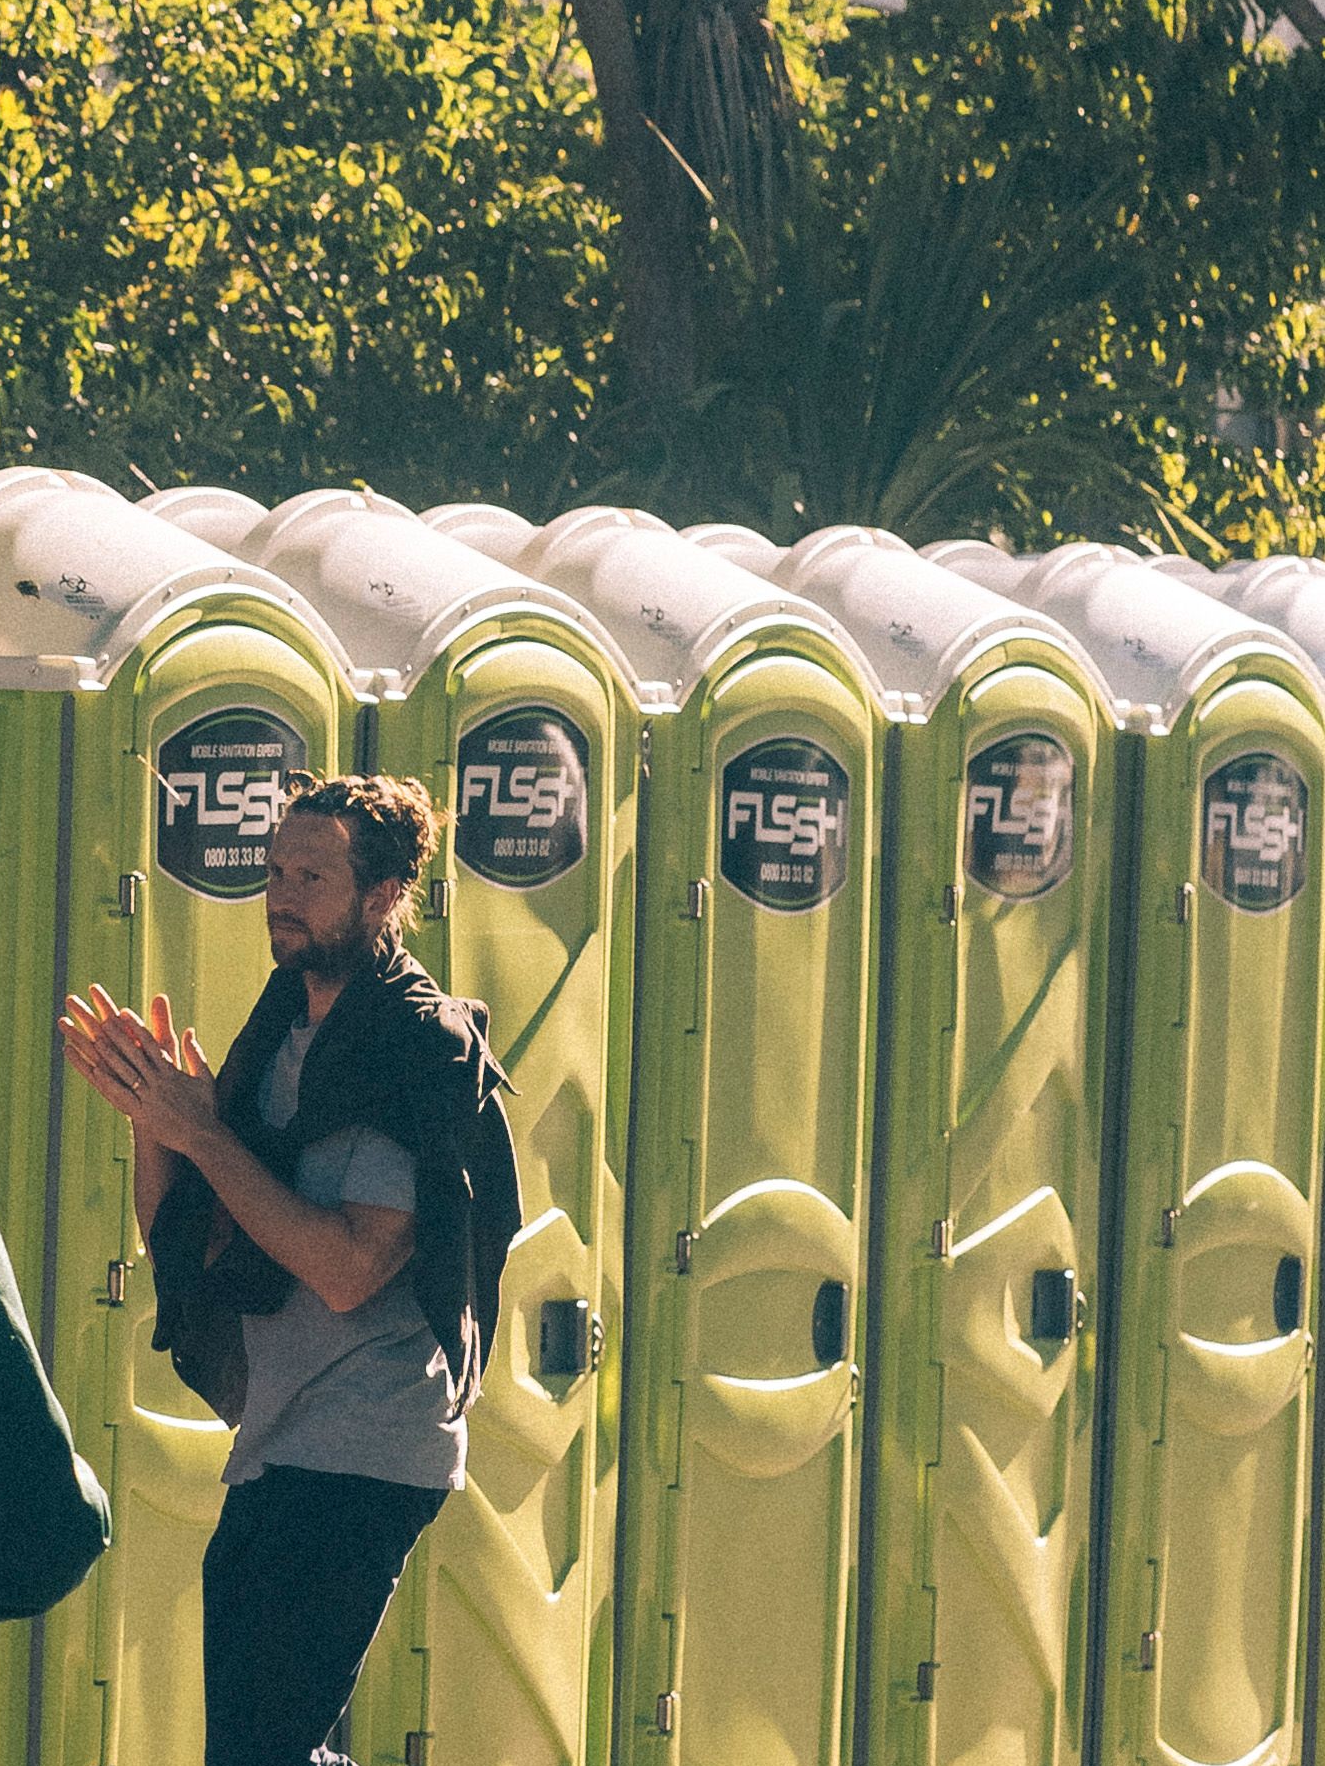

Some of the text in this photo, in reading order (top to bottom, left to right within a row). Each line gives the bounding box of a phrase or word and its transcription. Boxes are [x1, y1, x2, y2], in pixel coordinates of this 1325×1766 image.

[191, 742, 283, 758] MOBILE SANITATION EXPERTS
[204, 847, 226, 868] 0800
[228, 847, 239, 867] 33
[241, 847, 252, 866] 33
